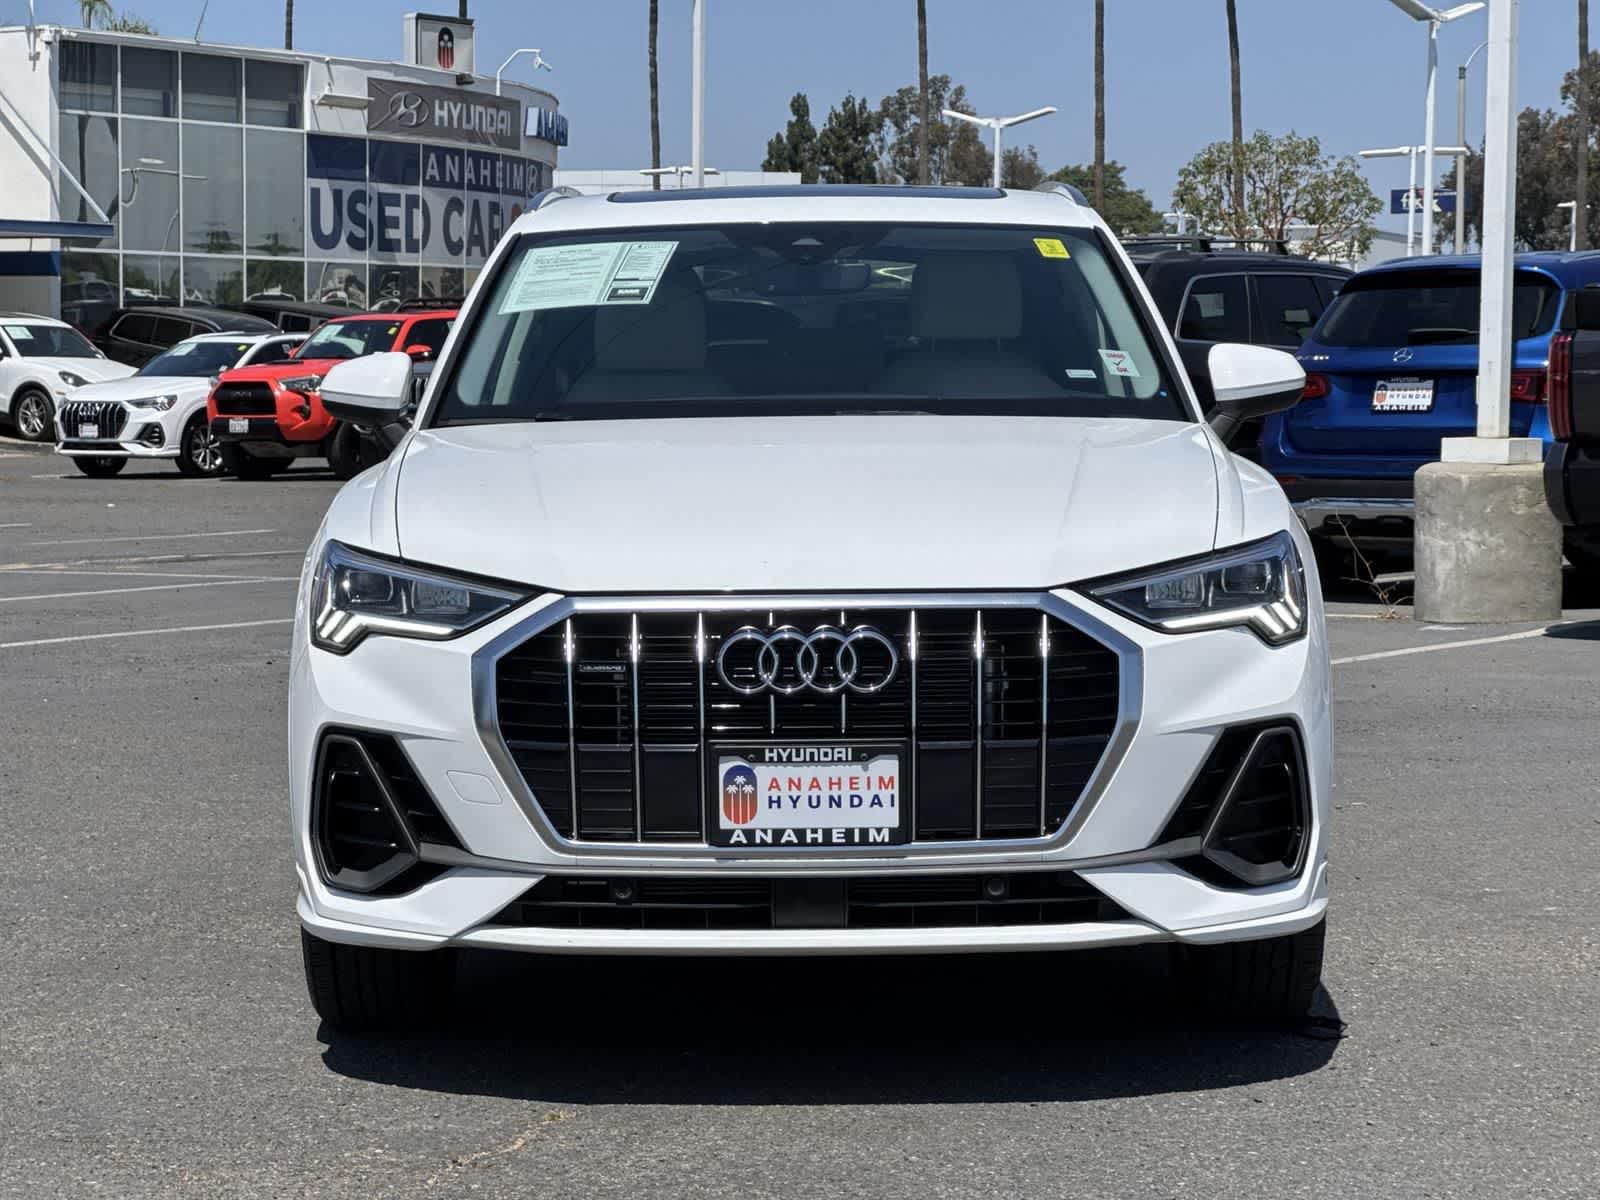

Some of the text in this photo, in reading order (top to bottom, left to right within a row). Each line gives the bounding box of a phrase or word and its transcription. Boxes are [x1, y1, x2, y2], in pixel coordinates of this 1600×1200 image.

[434, 100, 511, 136] HYUNDAI
[425, 152, 524, 192] ANAHEIM
[310, 187, 431, 253] USED
[765, 748, 852, 762] HYUNDAI
[768, 776, 895, 791] ANAHEIM
[768, 794, 895, 809] HYUNDAI
[729, 828, 890, 843] ANAHEIM
